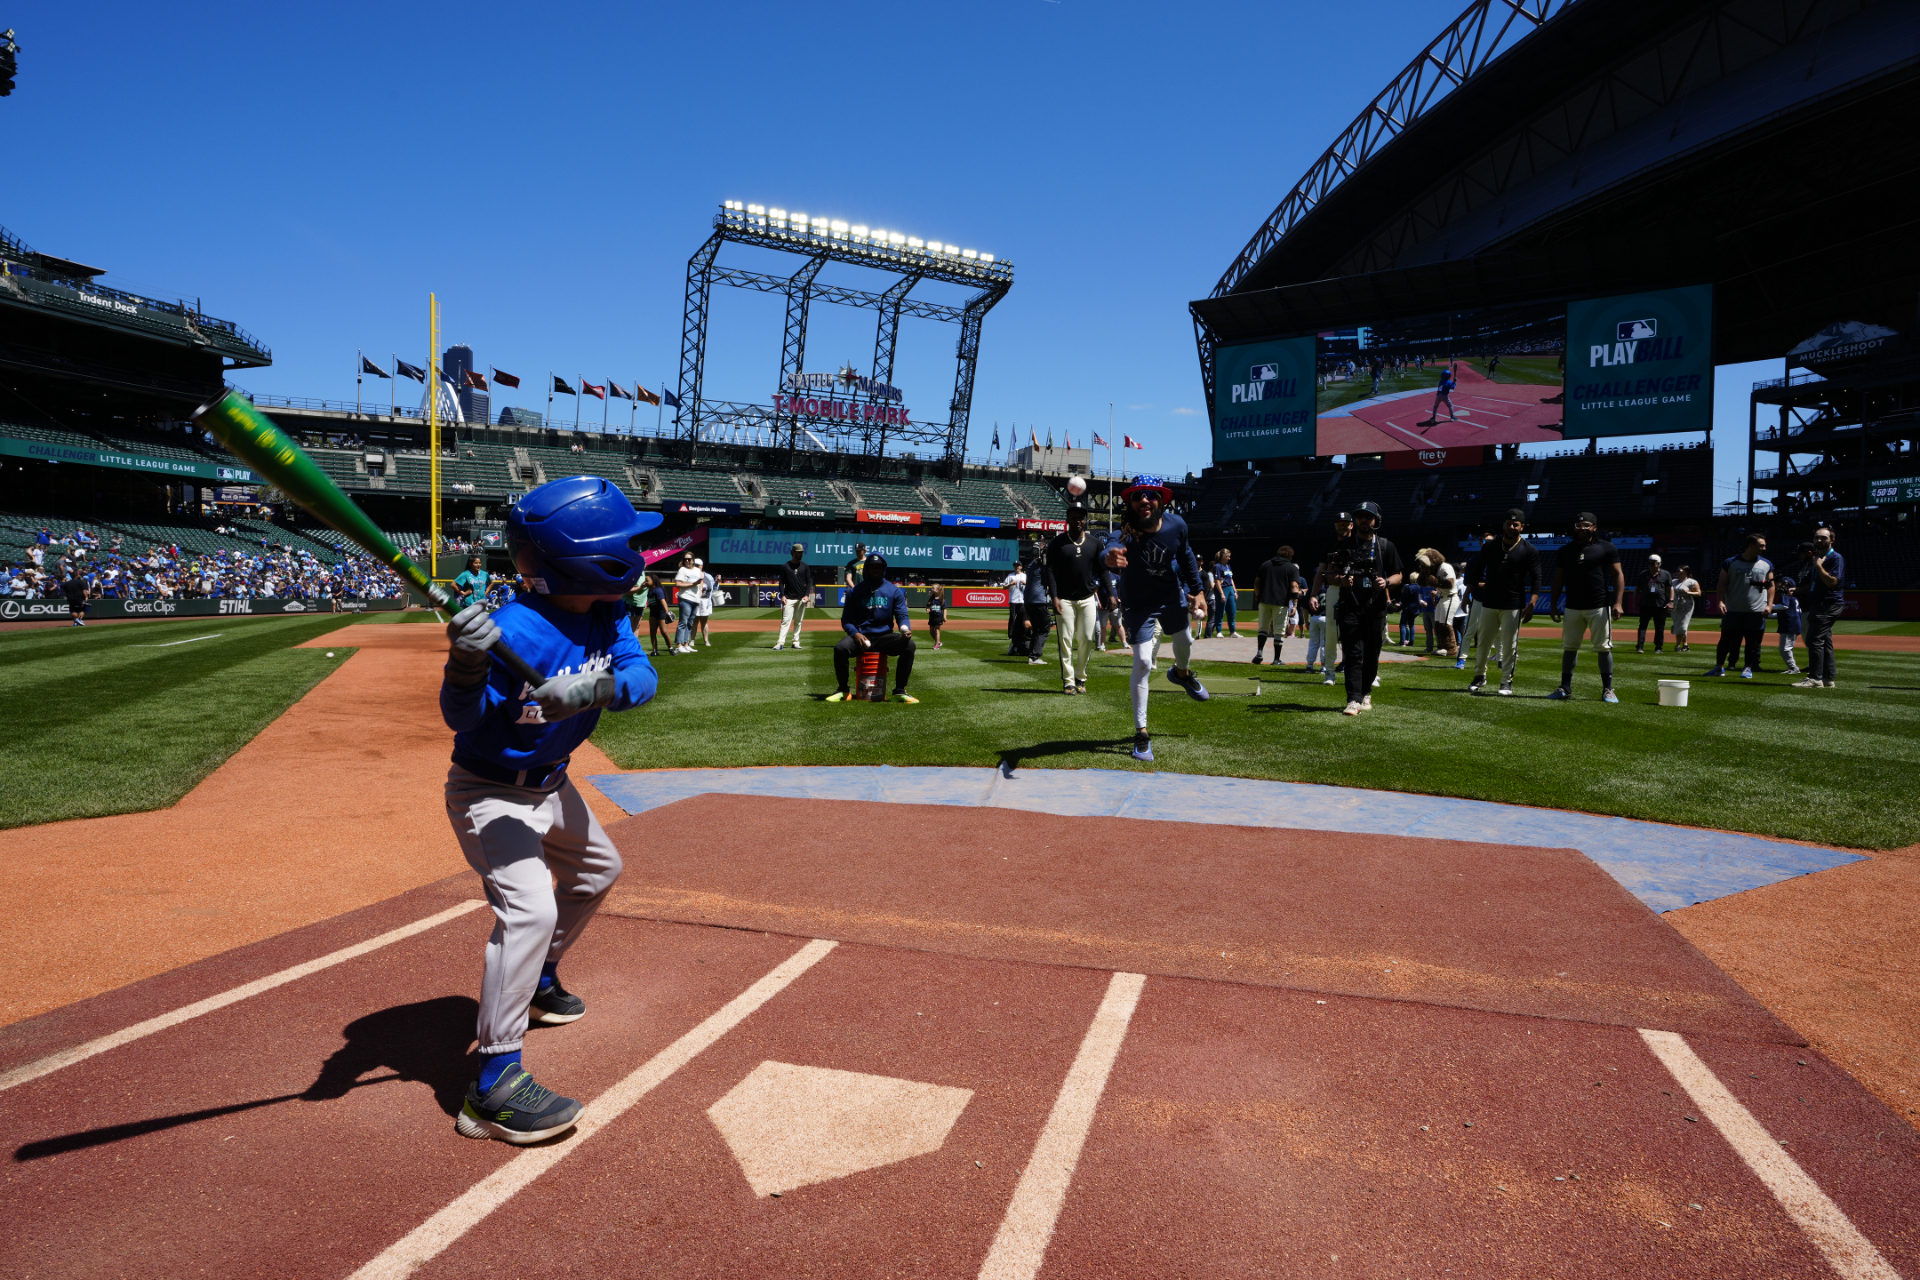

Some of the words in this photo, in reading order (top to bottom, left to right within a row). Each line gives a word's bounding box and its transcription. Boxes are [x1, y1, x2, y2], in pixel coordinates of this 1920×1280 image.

[78, 291, 113, 308] Trident
[114, 301, 138, 314] Deck
[1799, 338, 1885, 362] MUCKLESHOOT
[787, 373, 833, 389] SEATTLE
[857, 375, 903, 402] MARINERS
[1573, 373, 1702, 401] CHALLENGER
[1581, 401, 1615, 410] LITTLE
[1618, 397, 1658, 407] LEAGUE
[1662, 393, 1692, 404] GAME
[771, 394, 860, 421] T-MOBILE
[864, 404, 911, 426] PARK
[1220, 409, 1310, 431] CHALLENGER
[1226, 430, 1250, 439] LITTLE
[1252, 428, 1280, 437] LEAGUE
[1282, 425, 1303, 434] GAME
[28, 445, 97, 462] CHALLENGER
[100, 454, 132, 466] LITTLE
[135, 459, 170, 471] LEAGUE
[172, 463, 196, 473] GAME
[1418, 450, 1435, 460] fire
[1436, 450, 1447, 459] tv
[787, 509, 825, 517] STARBUCKS
[815, 544, 854, 555] LITTLE
[865, 545, 900, 556] EAGUE
[904, 546, 933, 557] GAME
[969, 593, 1002, 601] Nintendo
[21, 604, 70, 615] LEXUS
[124, 600, 152, 613] Great
[154, 600, 175, 614] Clips
[219, 599, 252, 614] STIHL
